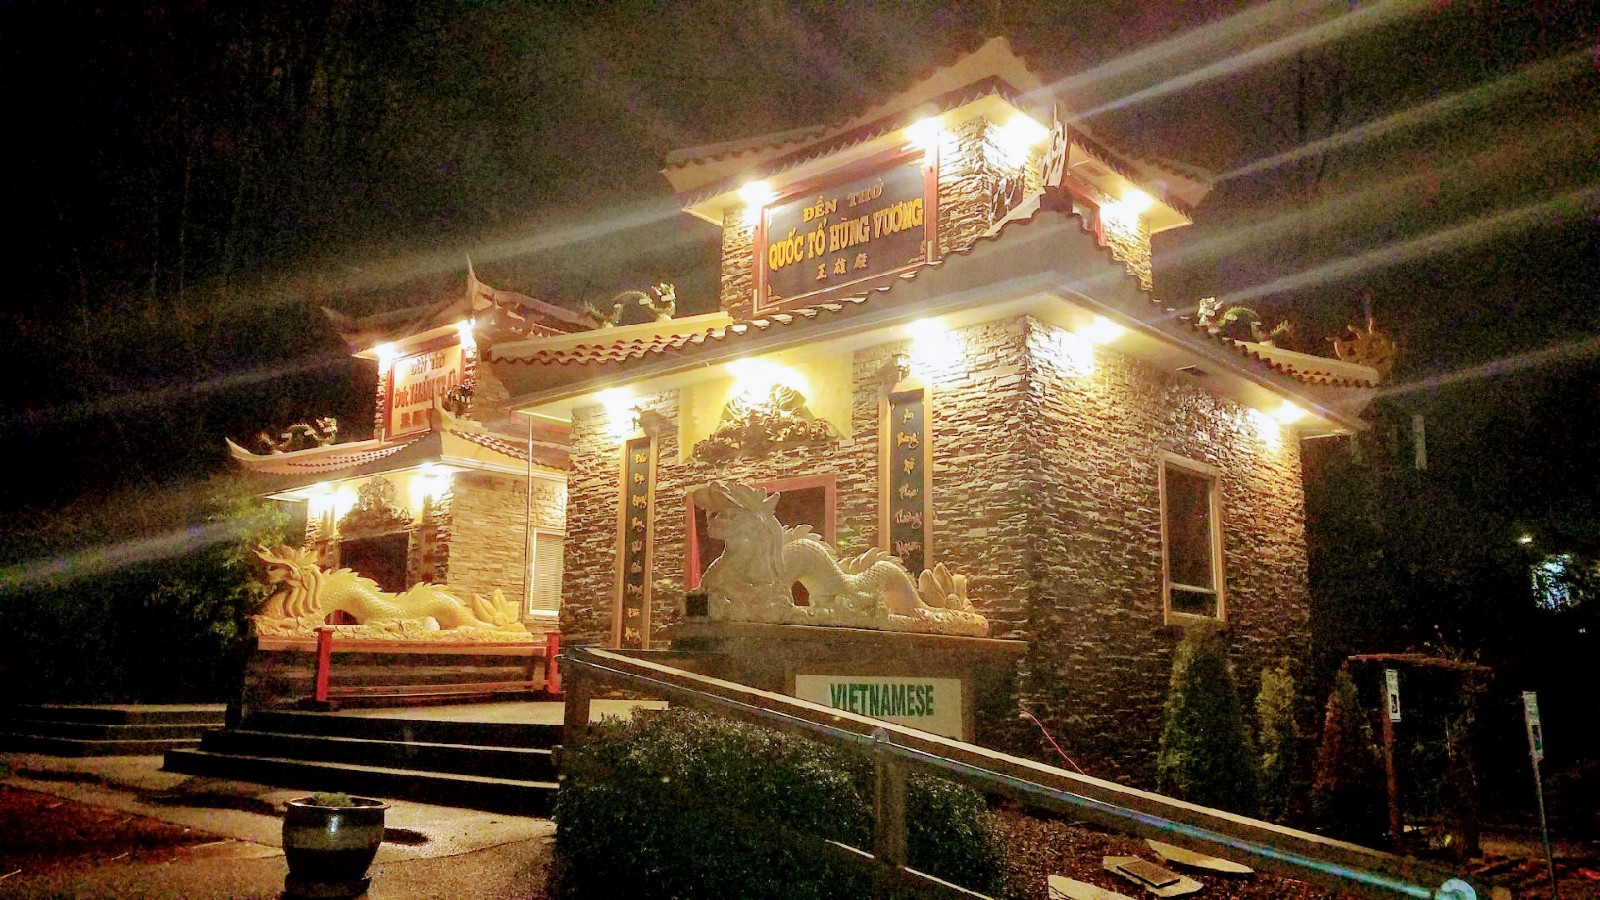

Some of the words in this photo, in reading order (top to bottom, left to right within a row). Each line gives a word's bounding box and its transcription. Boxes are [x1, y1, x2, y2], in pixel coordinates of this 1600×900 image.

[803, 195, 838, 223] ĐỀN
[768, 227, 805, 271] QUỐC
[807, 217, 828, 259] TỔ
[829, 215, 871, 252] HÙNG
[873, 198, 924, 239] VƯƠNG
[830, 683, 934, 717] VIETNAMESE
